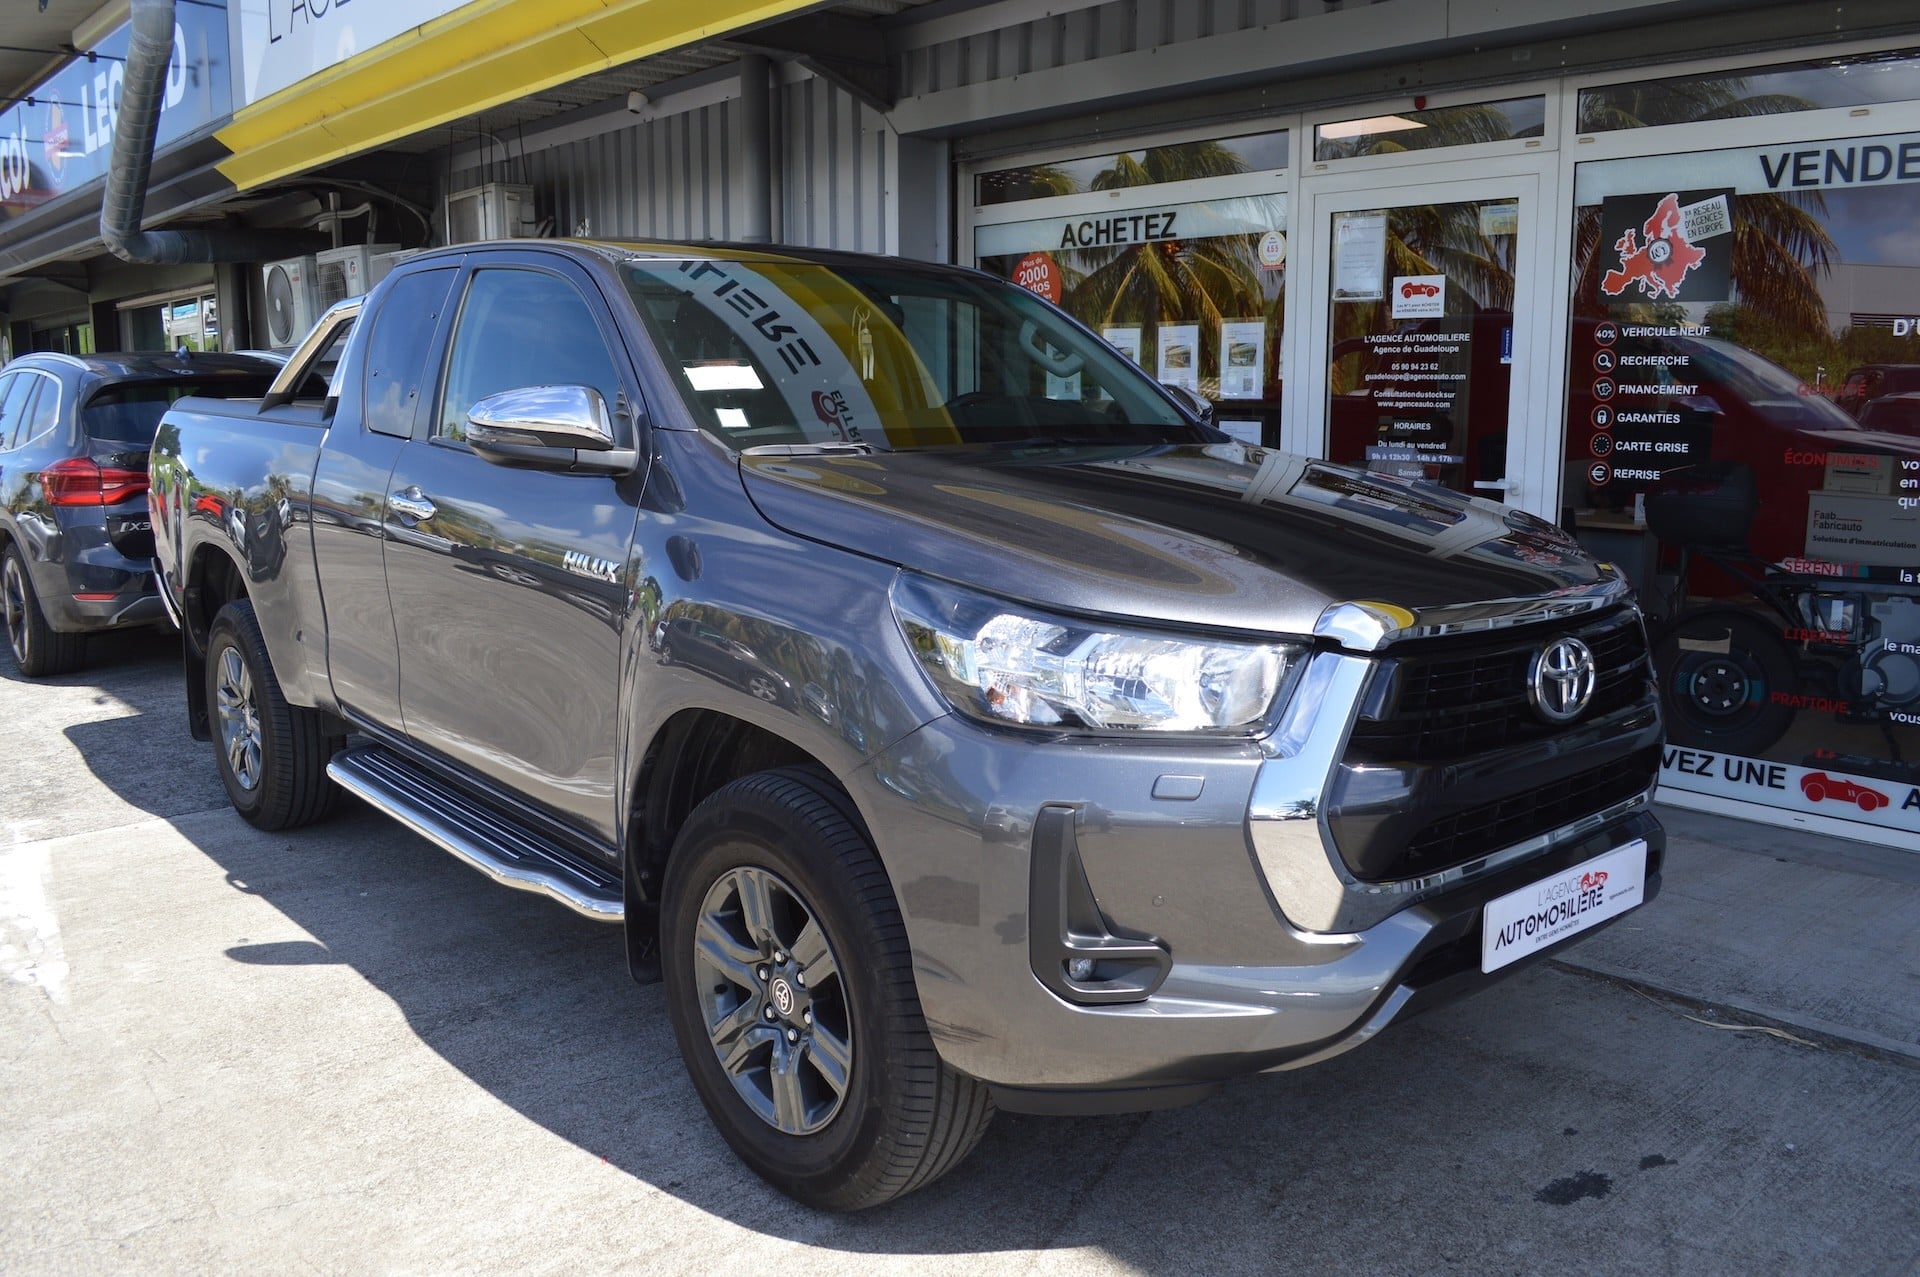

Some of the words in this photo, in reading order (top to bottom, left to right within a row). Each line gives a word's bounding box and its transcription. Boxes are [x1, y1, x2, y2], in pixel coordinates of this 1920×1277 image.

[1760, 142, 1920, 188] VENDE
[1060, 212, 1177, 248] ACHETEZ
[1688, 230, 1697, 238] EN
[1699, 220, 1724, 235] EUROPE
[1019, 263, 1048, 286] 2000
[1621, 327, 1677, 337] VEHICULE
[1679, 326, 1711, 337] NEUF
[1364, 334, 1403, 343] L'AGENCE
[1404, 333, 1471, 342] AUTOMOBILIERE
[1373, 345, 1401, 355] Agence
[1402, 345, 1412, 353] de
[1413, 345, 1460, 354] Guadeloupe
[1620, 355, 1690, 366] RECHERCHE
[1618, 384, 1699, 395] FINANCEMENT
[1616, 413, 1681, 424] GARANTIES
[1393, 422, 1432, 430] HORAIRES
[1389, 440, 1406, 448] lundi
[1416, 442, 1447, 450] vendredi
[1615, 441, 1652, 451] CARTE
[1654, 442, 1690, 453] GRISE
[1398, 469, 1424, 477] Samedi
[1613, 468, 1661, 480] REPRISE
[1899, 478, 1918, 489] en
[1813, 520, 1863, 532] Fabricauto
[562, 550, 620, 584] HILUX
[1900, 569, 1913, 583] la
[1883, 638, 1897, 650] le
[1769, 691, 1849, 714] PRATIQUE
[1723, 758, 1787, 790] UNE
